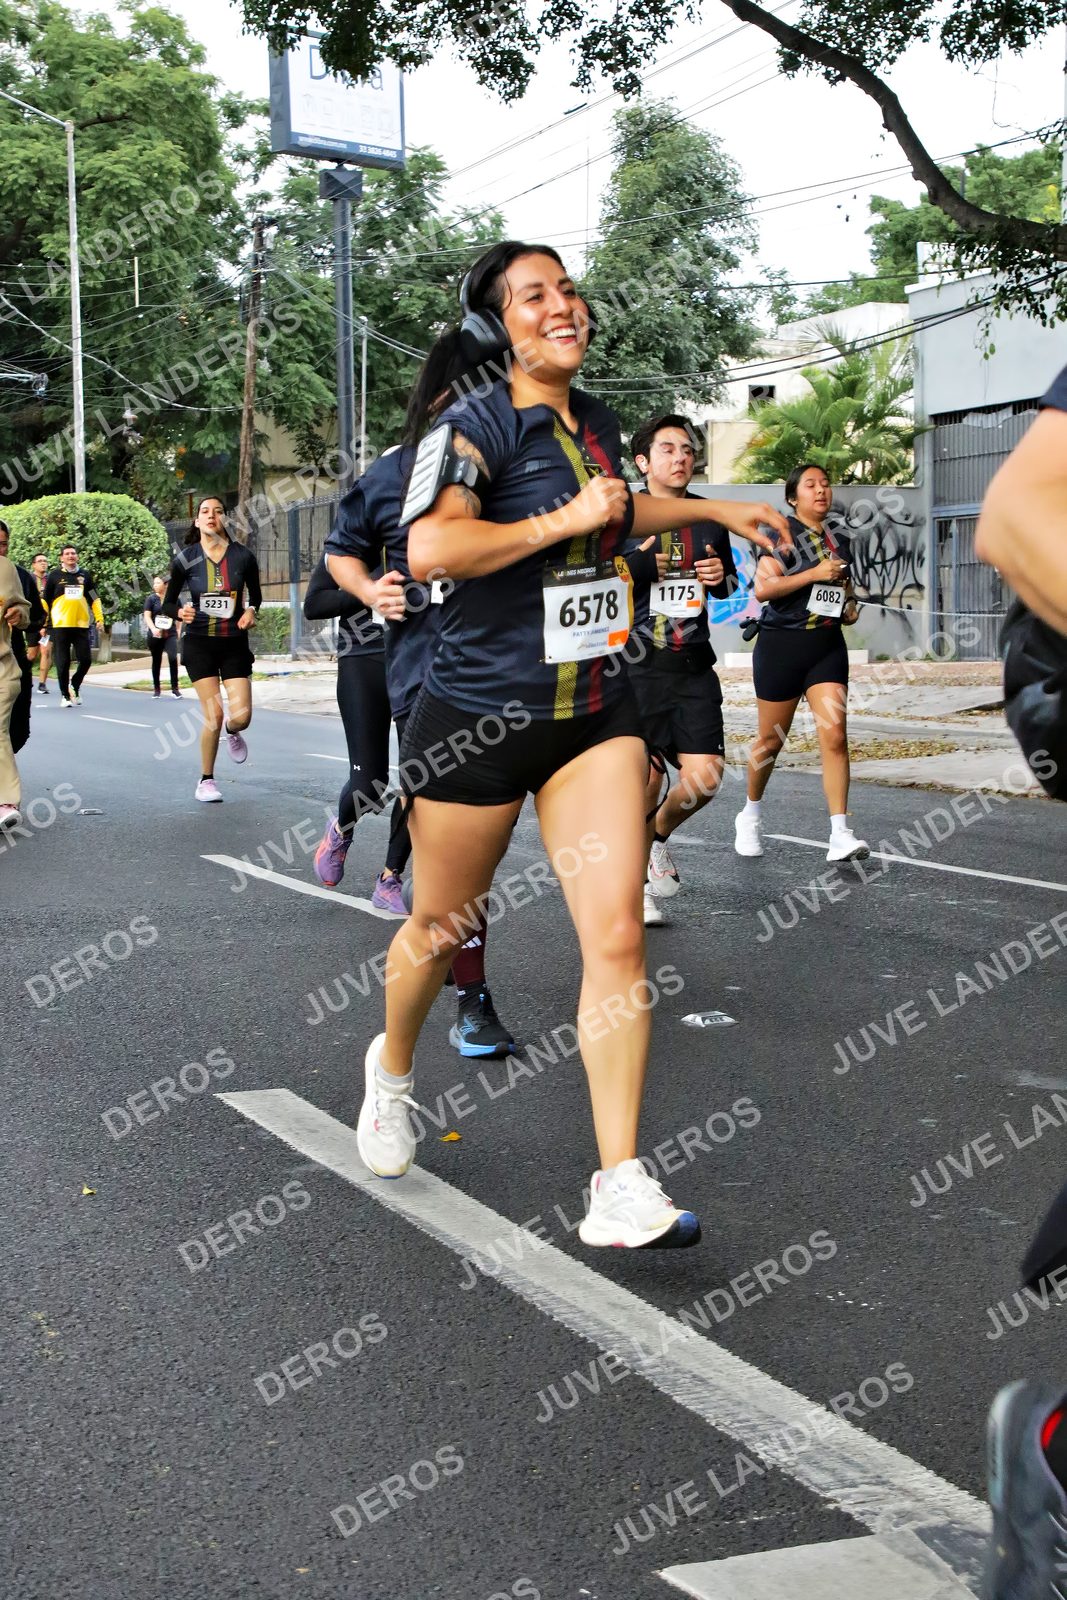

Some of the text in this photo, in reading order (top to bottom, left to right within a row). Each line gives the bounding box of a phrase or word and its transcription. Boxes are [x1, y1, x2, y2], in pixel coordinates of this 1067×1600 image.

[658, 585, 695, 601] 1175
[815, 589, 841, 604] 6082
[204, 600, 228, 609] 5231
[559, 589, 619, 628] 6578
